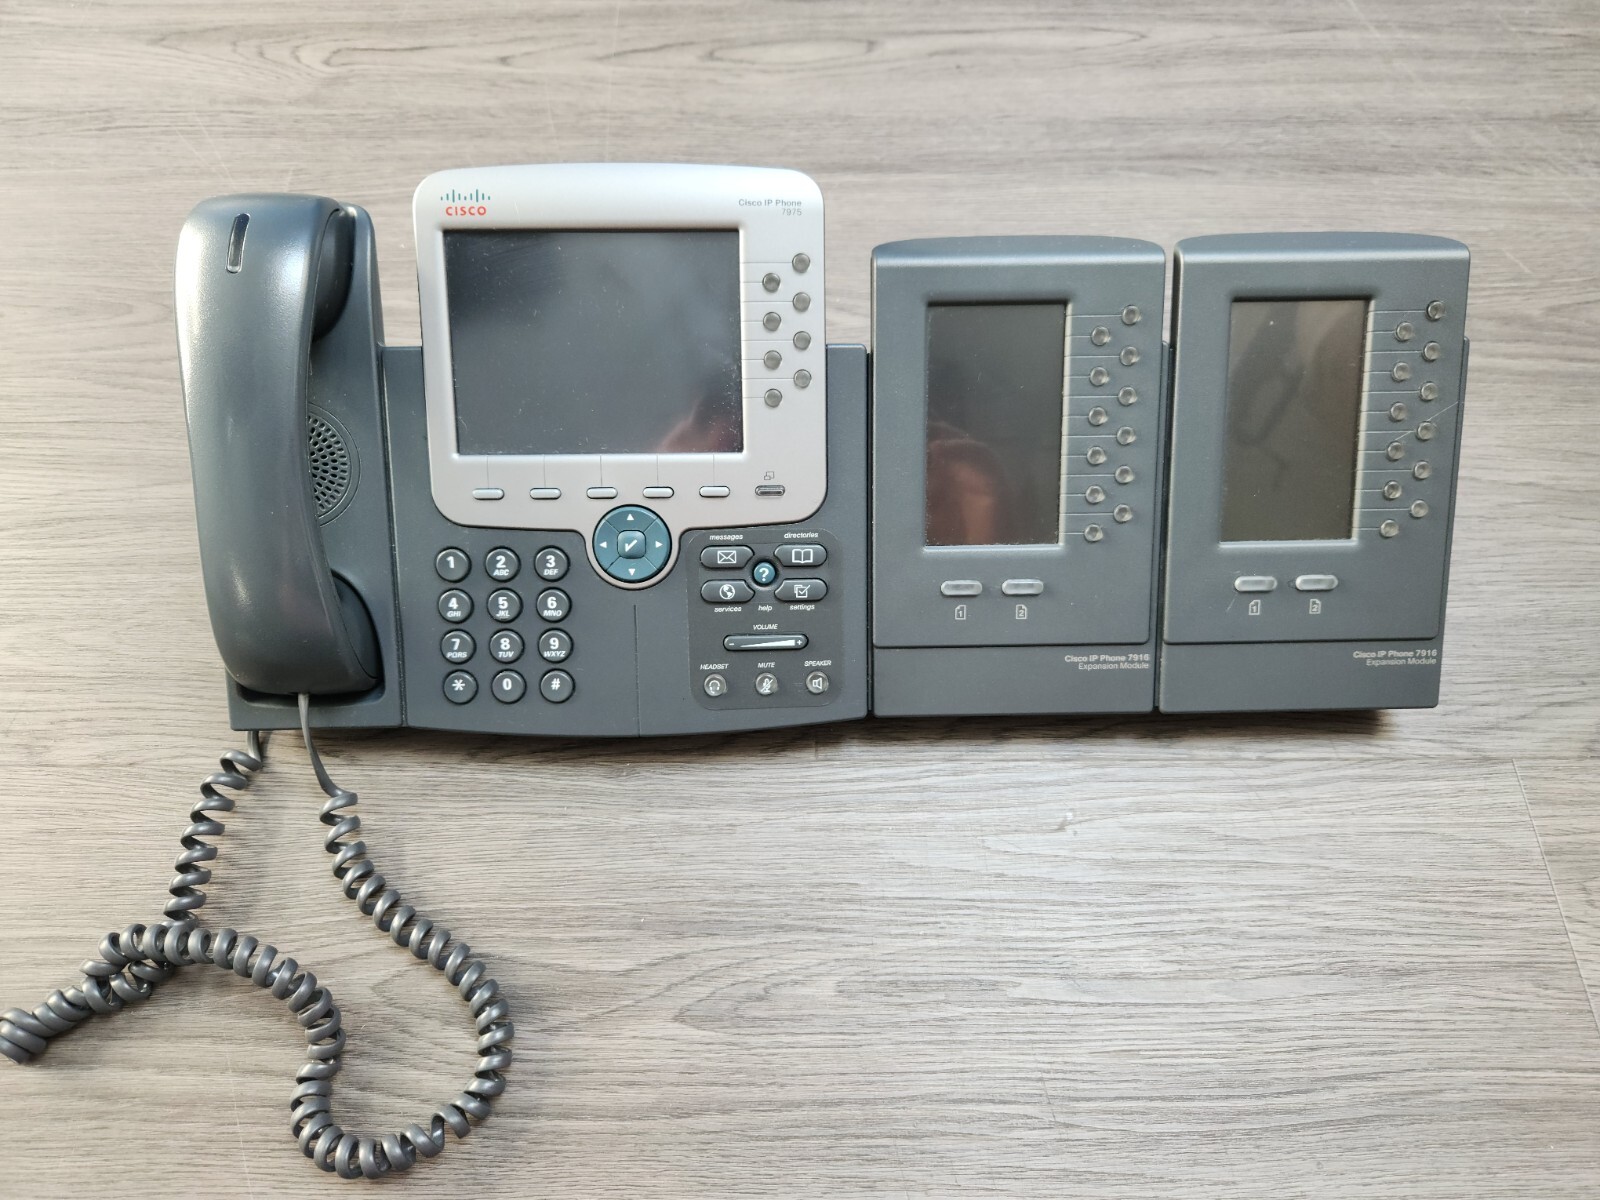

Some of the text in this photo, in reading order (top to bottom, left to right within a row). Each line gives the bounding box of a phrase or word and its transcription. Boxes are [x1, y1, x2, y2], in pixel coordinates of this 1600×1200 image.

[738, 198, 802, 207] Cisco IP Phone
[445, 205, 487, 217] CISCO
[782, 208, 802, 216] 7975
[709, 533, 744, 541] messages
[784, 531, 819, 539] directories
[446, 555, 455, 569] 1
[495, 555, 507, 568] 2
[545, 554, 556, 568] 3
[493, 568, 510, 577] ABC
[543, 568, 559, 576] DEF
[448, 597, 459, 610] 4
[498, 596, 509, 609] 5
[546, 596, 557, 609] 6
[758, 604, 773, 612] help
[447, 610, 462, 618] GHI
[496, 610, 511, 618] JKL
[451, 638, 461, 651] 7
[499, 637, 511, 651] 8
[549, 637, 559, 650] 9
[447, 651, 468, 659] PQRS
[543, 650, 566, 658] WXYZ
[1064, 653, 1150, 663] Cisco IP Phone 7916
[1352, 649, 1438, 659] Cisco IP Phone 7916
[1078, 661, 1149, 671] Expansion Module
[1366, 657, 1437, 667] Expansion Module
[502, 678, 512, 690] 0
